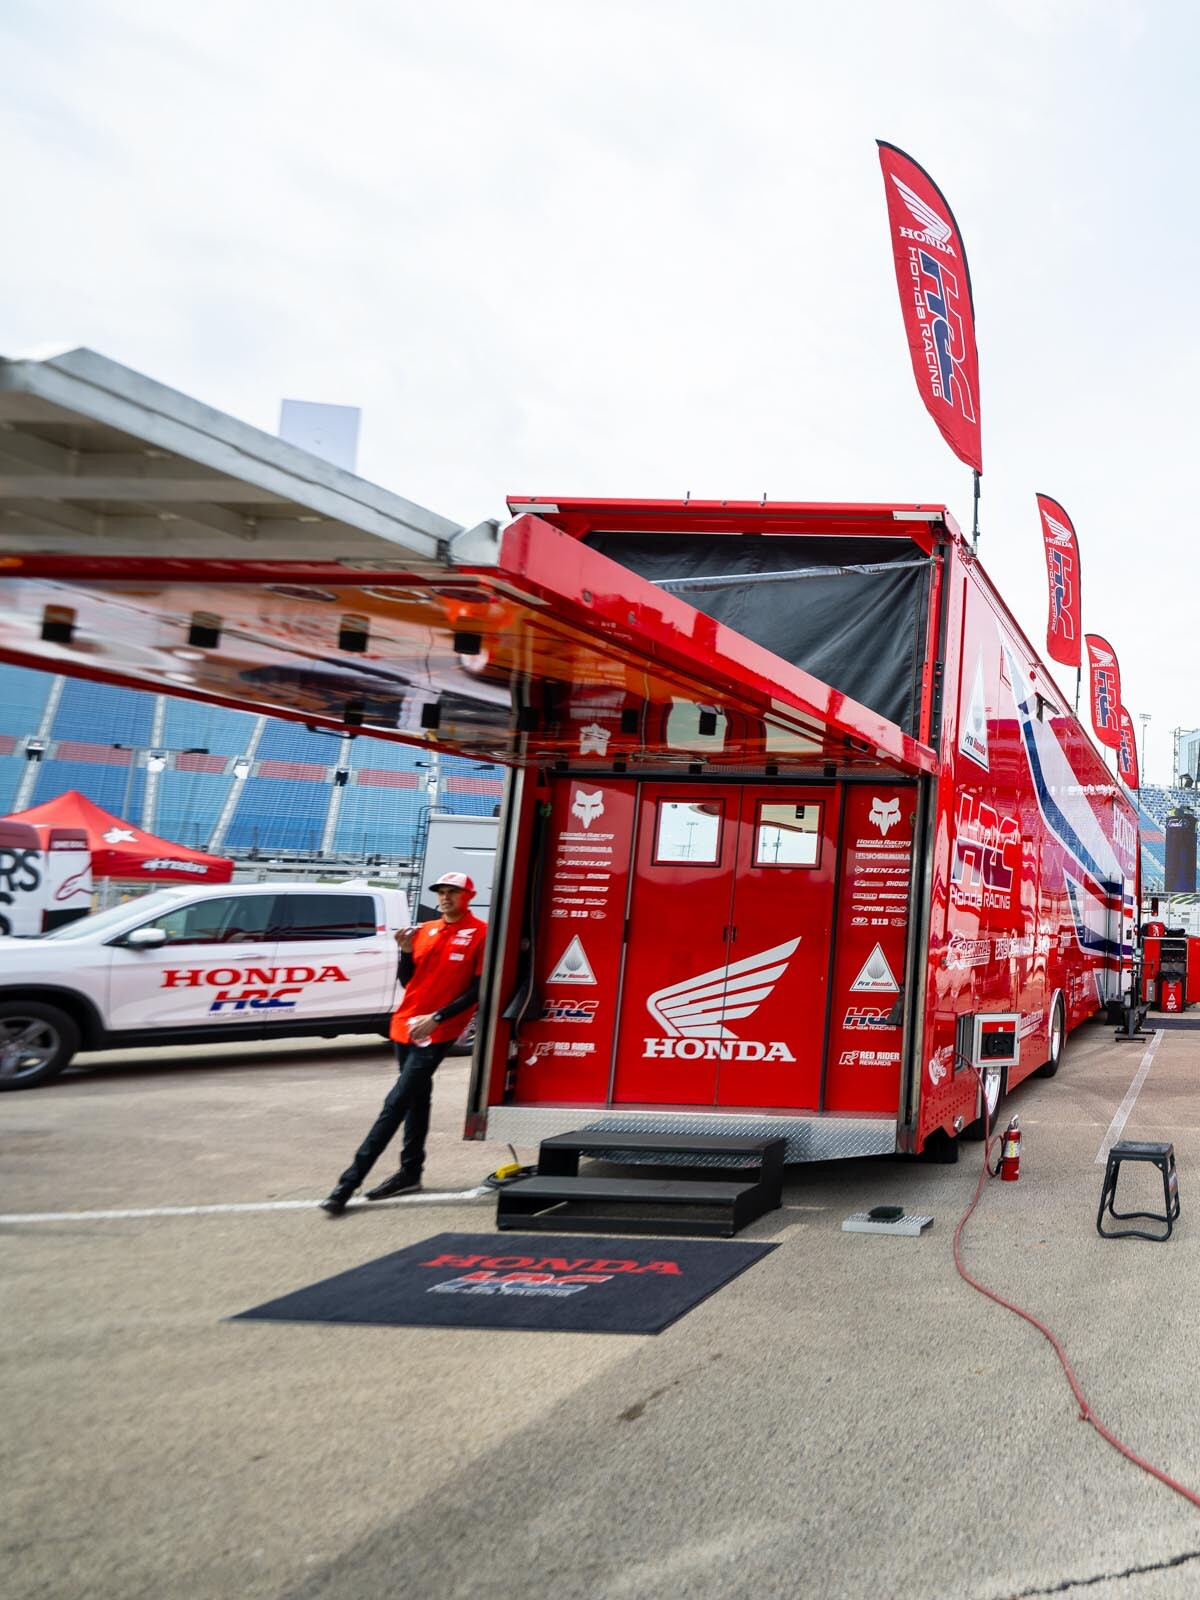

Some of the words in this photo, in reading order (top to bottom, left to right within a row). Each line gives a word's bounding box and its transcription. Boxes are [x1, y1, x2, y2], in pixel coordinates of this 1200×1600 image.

[899, 226, 957, 258] HONDA
[918, 248, 977, 424] HRC
[920, 323, 943, 399] RACING
[1045, 536, 1074, 549] HONDA
[1052, 547, 1074, 640] HRC
[1098, 669, 1119, 732] HRC
[883, 839, 912, 847] Racing
[950, 792, 1019, 893] HRC
[983, 892, 1012, 910] RACING
[160, 966, 350, 988] HONDA
[209, 987, 303, 1011] HRC
[543, 999, 600, 1018] HRC
[642, 1038, 797, 1062] HONDA
[859, 1051, 876, 1060] RED
[876, 1051, 900, 1061] RIDER
[419, 1254, 683, 1275] HONDA
[430, 1270, 616, 1291] HRC
